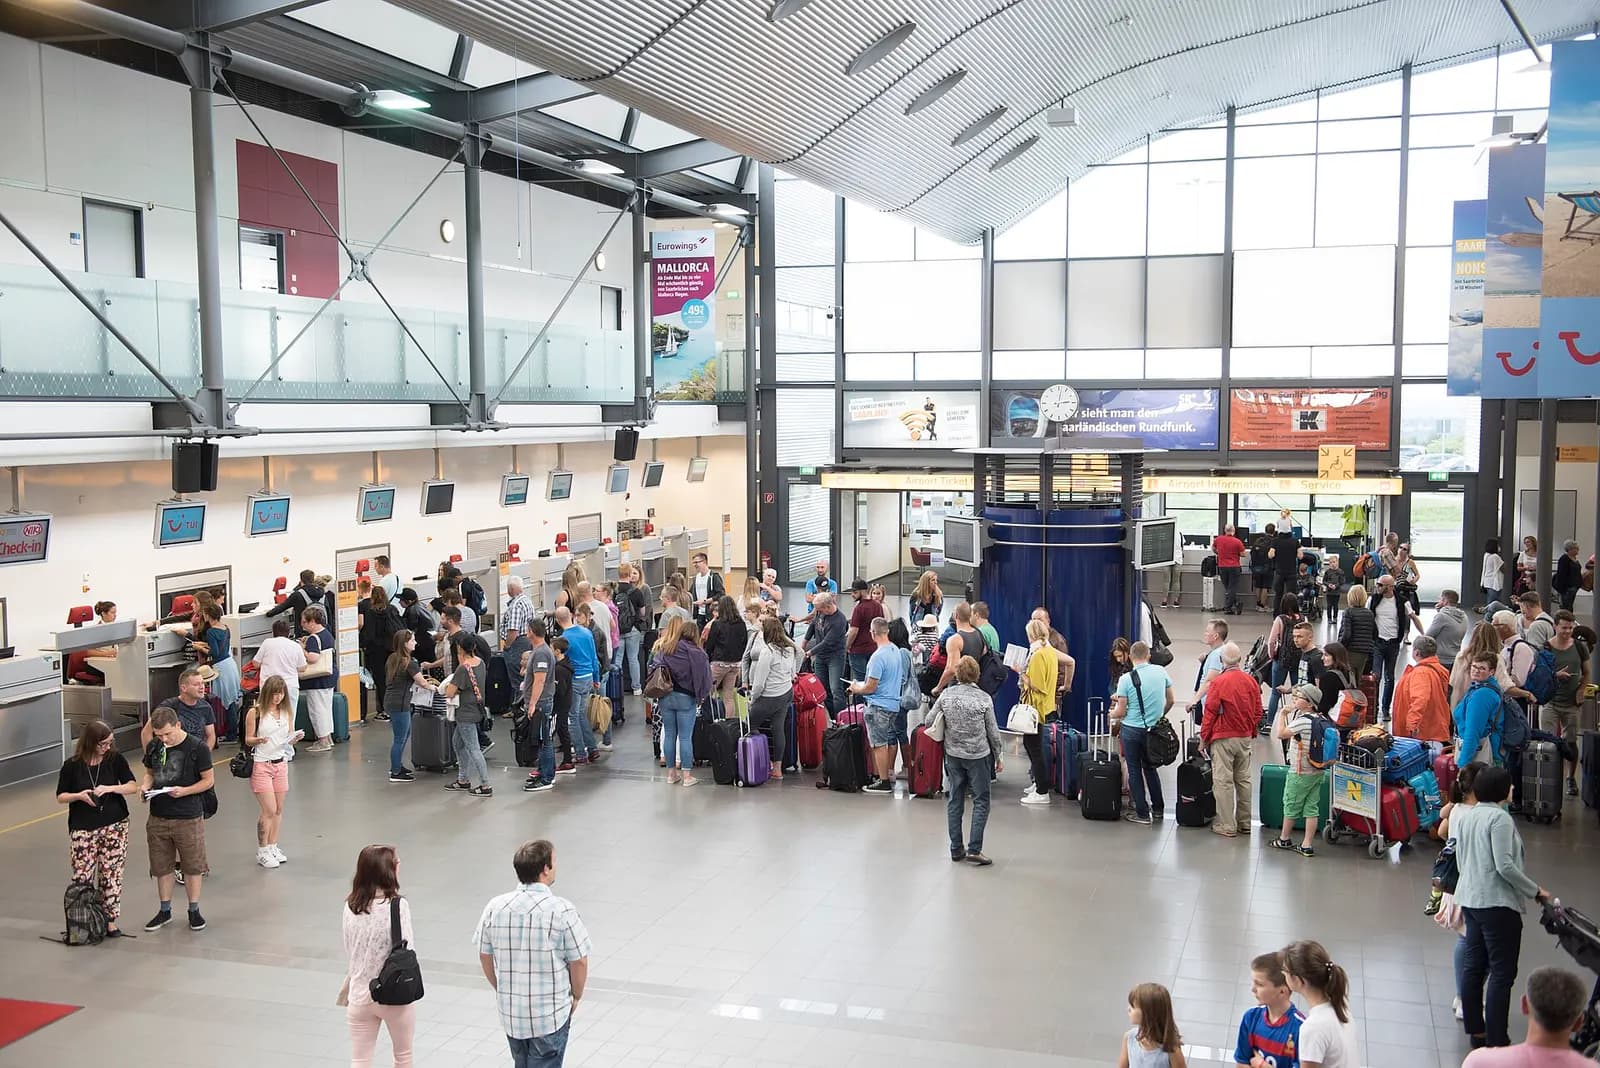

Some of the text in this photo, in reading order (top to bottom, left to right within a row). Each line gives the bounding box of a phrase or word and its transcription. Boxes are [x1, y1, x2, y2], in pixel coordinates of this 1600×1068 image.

[657, 242, 698, 252] Eurowings
[657, 262, 709, 273] MALLORCA
[1081, 407, 1107, 418] sieht
[1110, 410, 1134, 418] man
[1062, 421, 1197, 433] aarländischen Rundfunk.
[905, 476, 938, 487] Airport
[940, 476, 968, 486] Ticket
[1168, 479, 1270, 490] Airport Information
[1301, 480, 1341, 490] Service
[0, 540, 41, 555] Check-in
